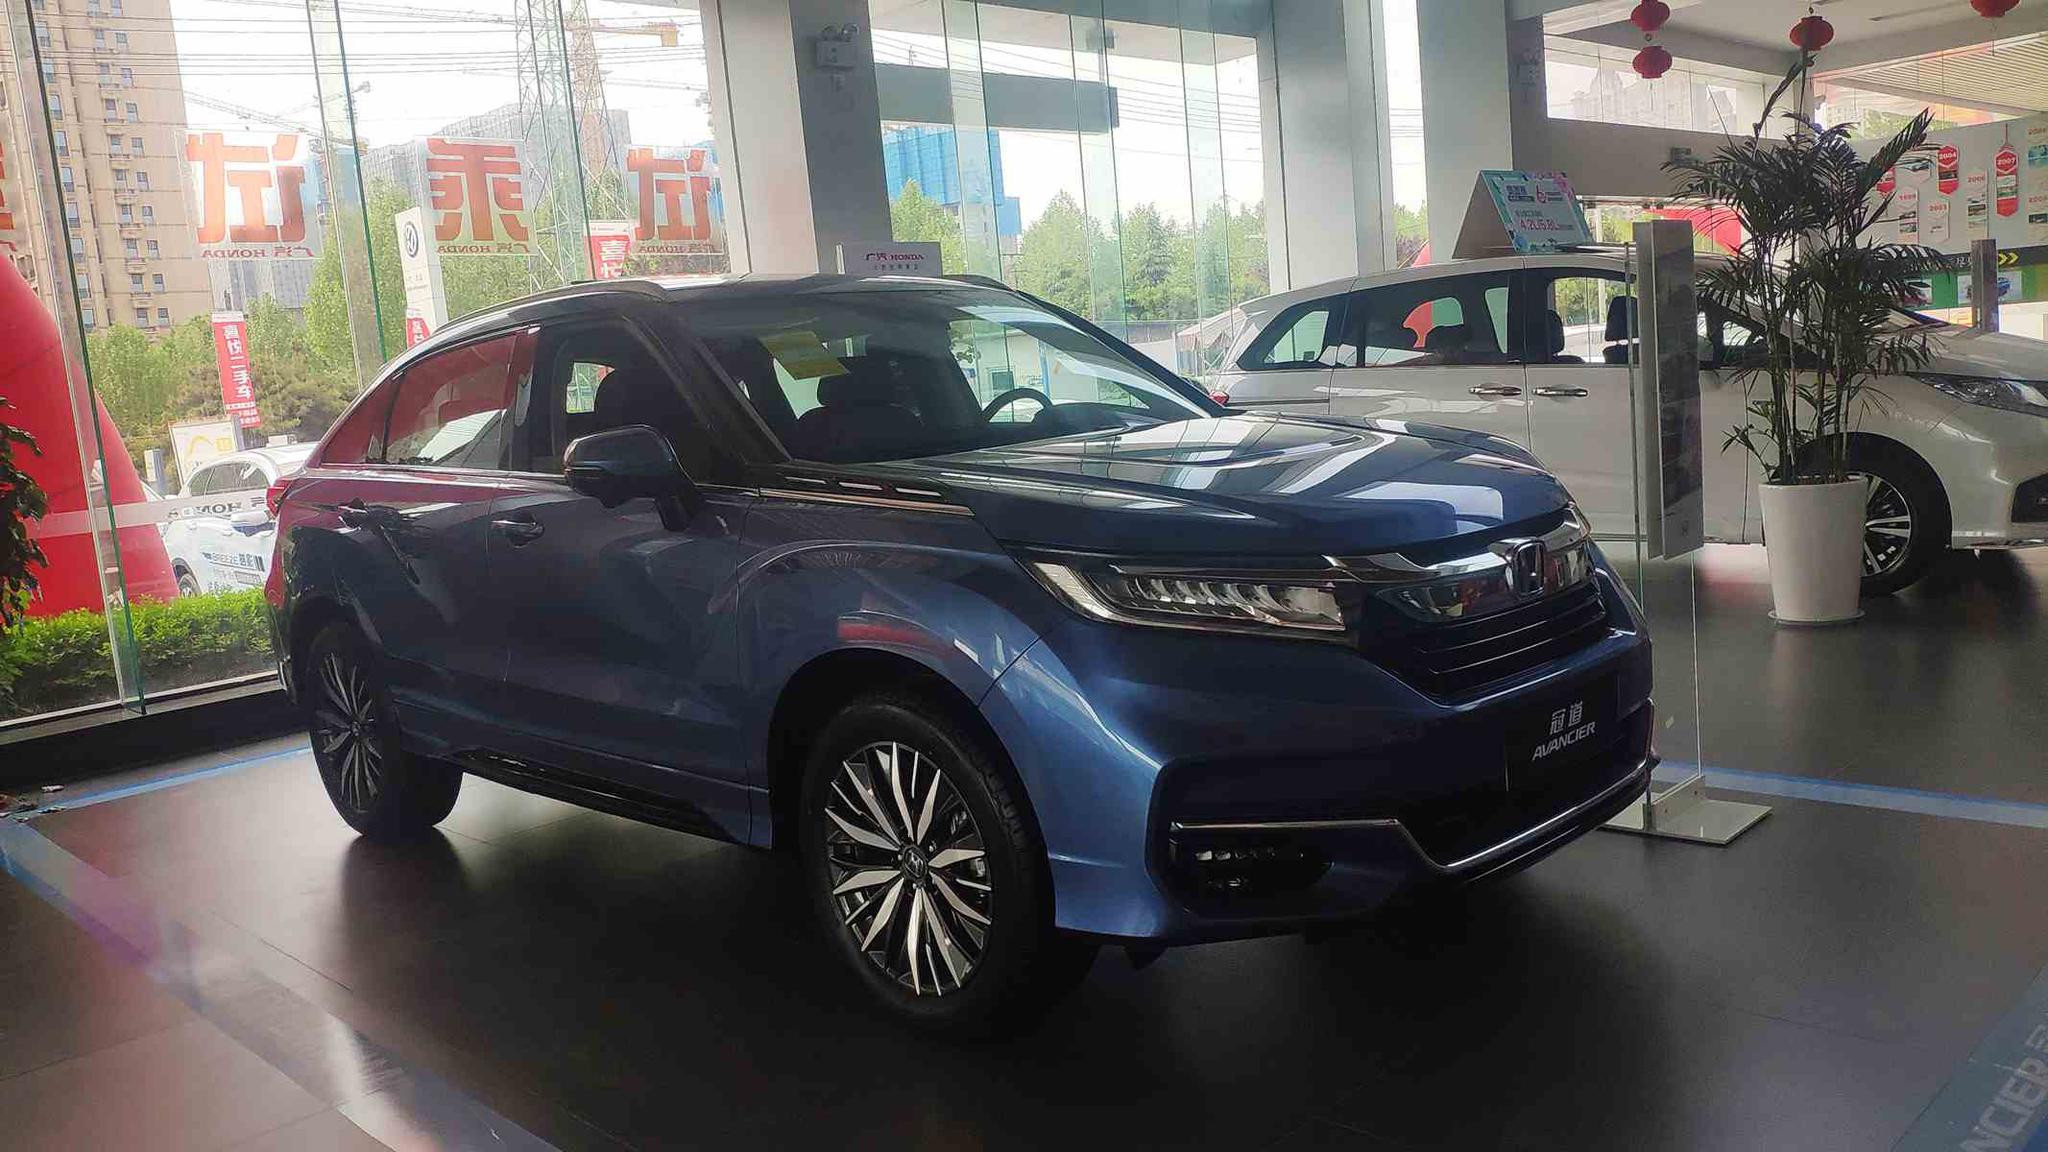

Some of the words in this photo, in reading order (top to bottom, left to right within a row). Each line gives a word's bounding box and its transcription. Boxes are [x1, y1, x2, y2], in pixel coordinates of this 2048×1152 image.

[1939, 151, 1957, 160] 2004
[1997, 156, 2016, 166] 2007
[889, 253, 925, 261] HONDA
[1549, 700, 1584, 736] 冠道
[1531, 721, 1597, 762] AVANCIER
